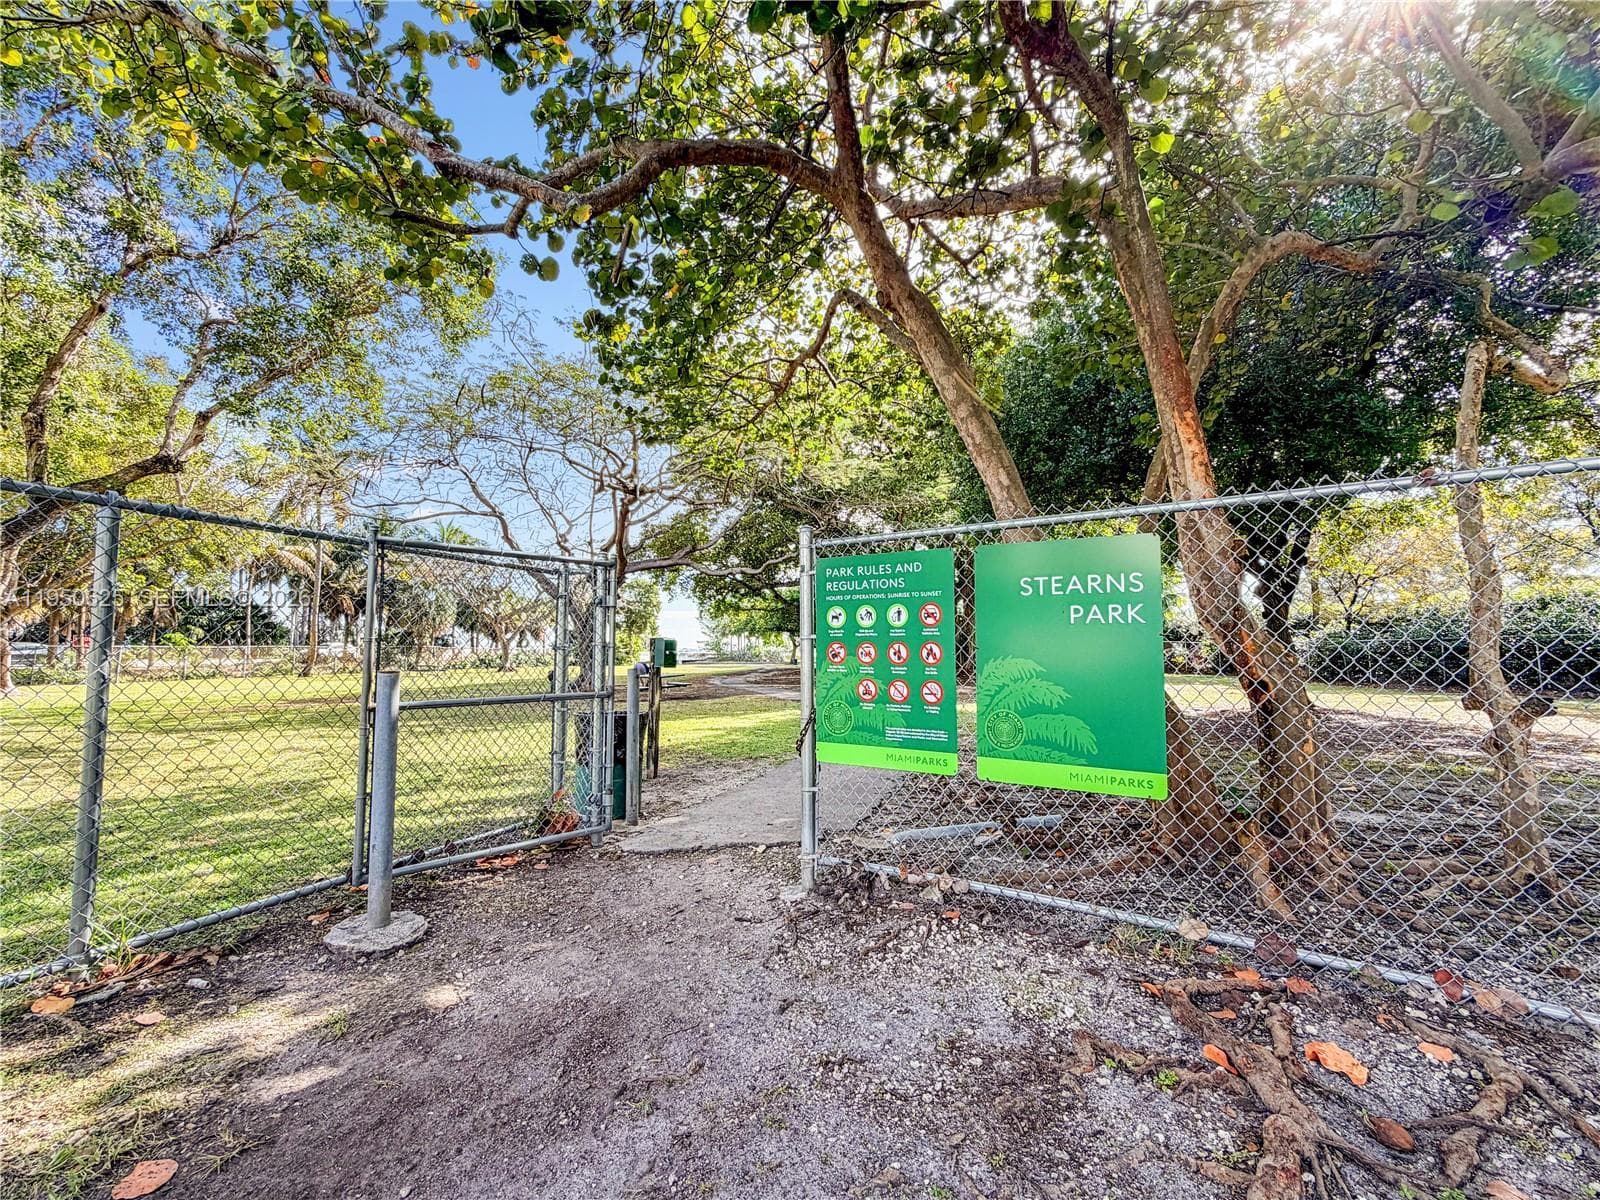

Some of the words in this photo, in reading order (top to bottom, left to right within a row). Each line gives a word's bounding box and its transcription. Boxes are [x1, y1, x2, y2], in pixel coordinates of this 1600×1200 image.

[826, 566, 854, 578] PARK
[857, 564, 892, 576] RULES
[895, 562, 922, 573] AND
[826, 577, 905, 591] REGULATIONS
[1019, 572, 1144, 596] STEARNS
[1070, 603, 1146, 624] PARK
[886, 753, 948, 767] MIAMIPARKS
[1069, 771, 1154, 790] MIAMIPARKS
